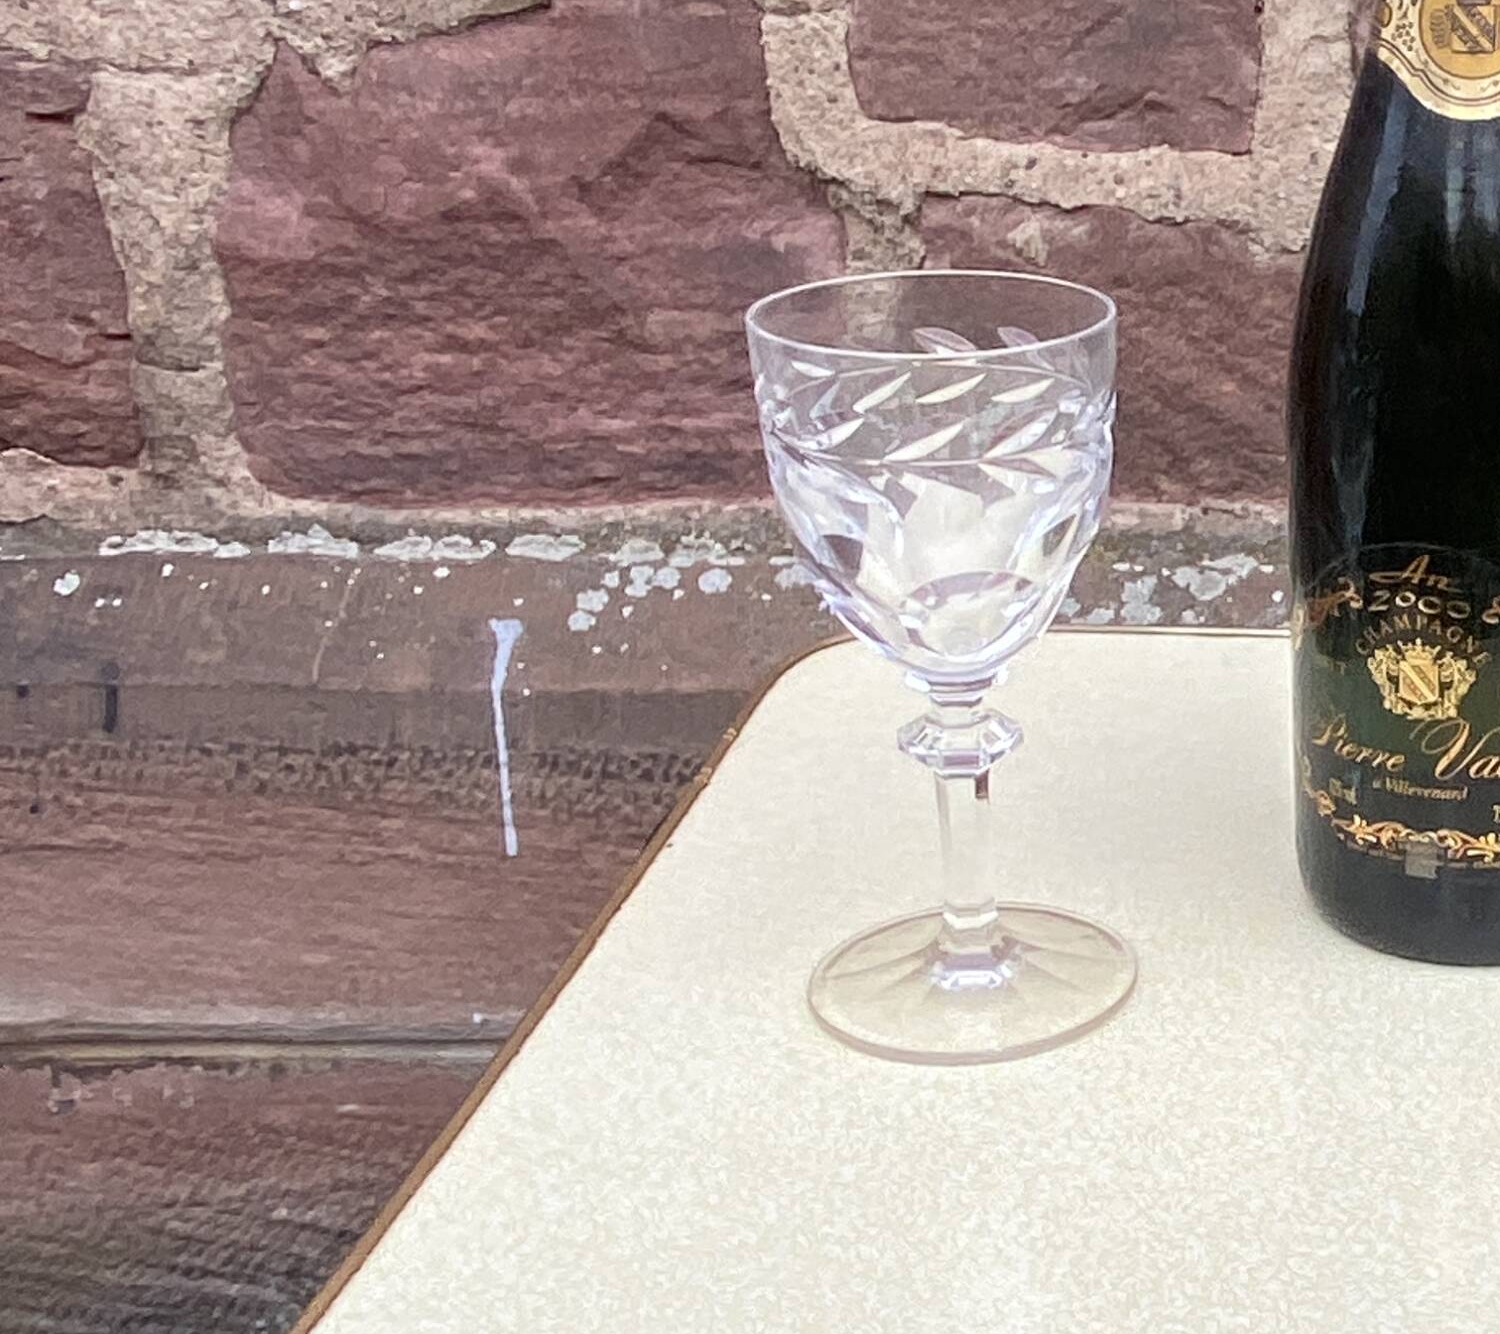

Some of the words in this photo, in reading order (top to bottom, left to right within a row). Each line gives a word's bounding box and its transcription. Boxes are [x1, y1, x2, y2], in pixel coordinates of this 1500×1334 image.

[1367, 589, 1472, 619] 2000
[1355, 614, 1493, 666] CHAMPAGNE
[1312, 714, 1406, 771] Pierre
